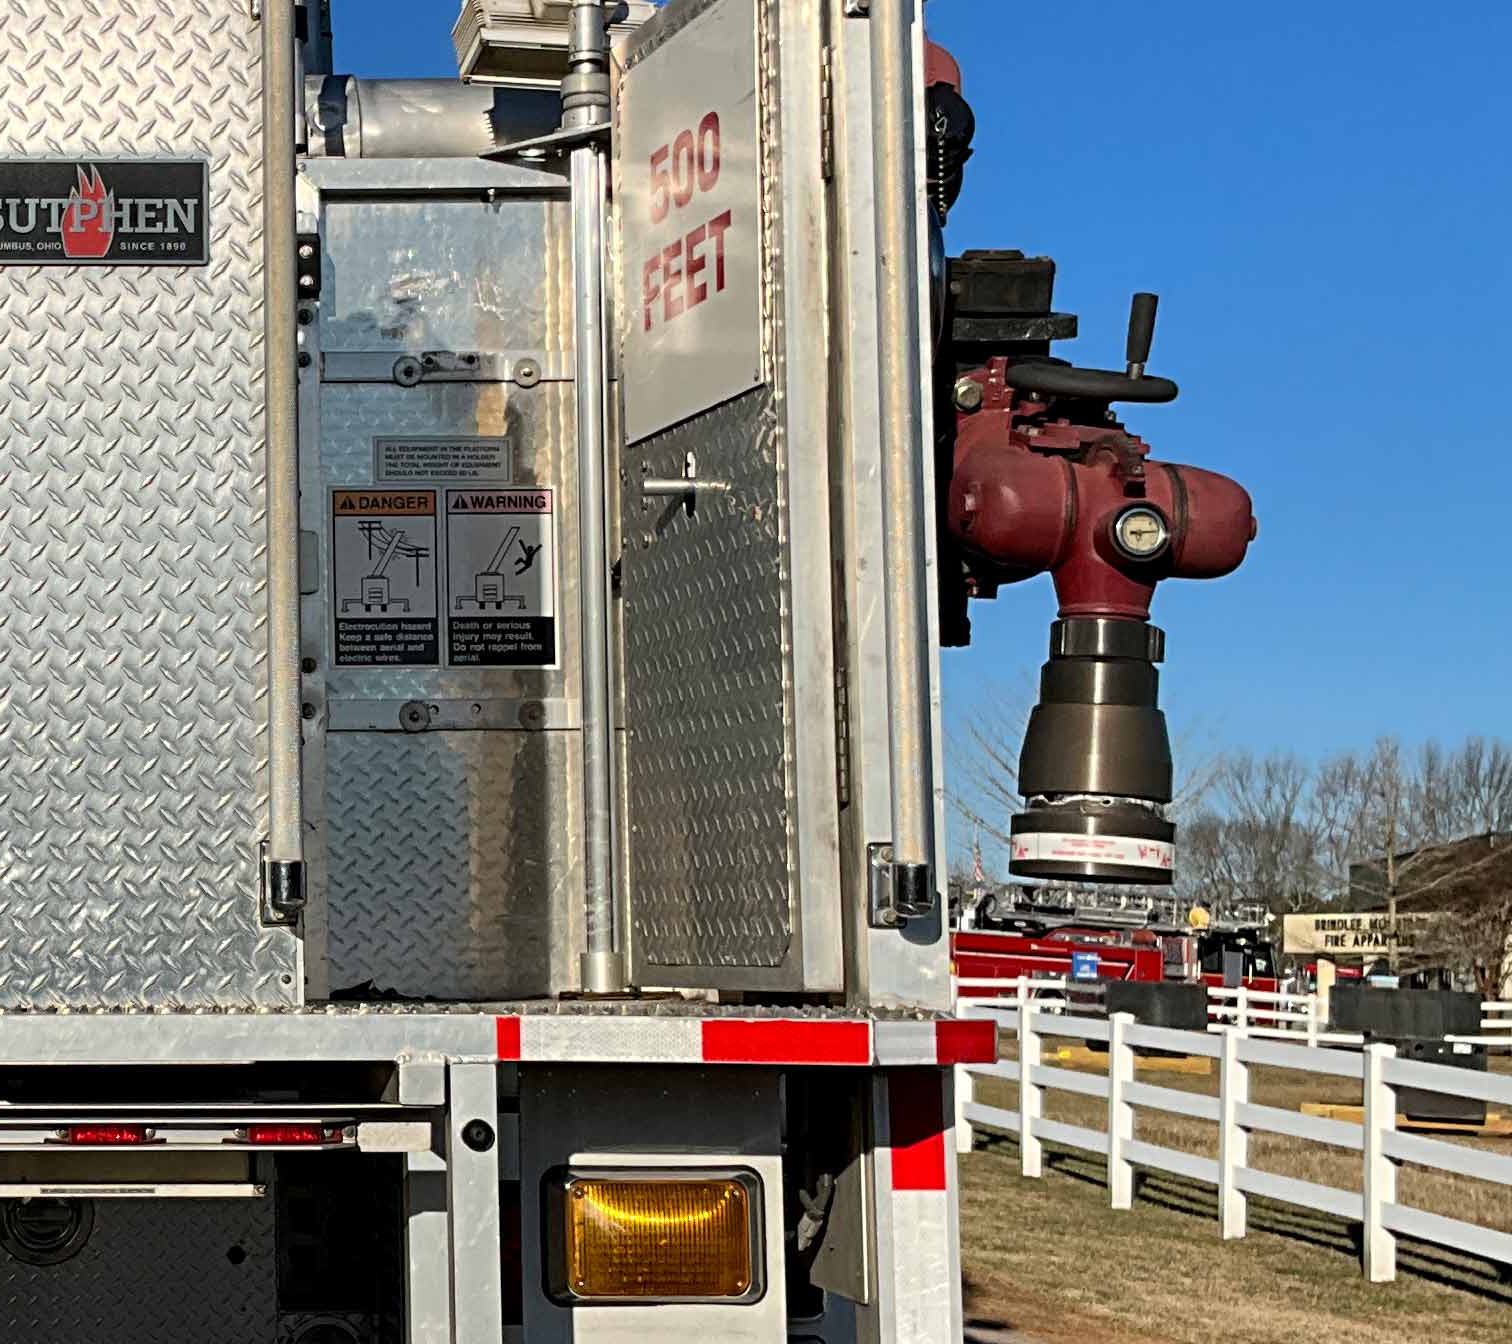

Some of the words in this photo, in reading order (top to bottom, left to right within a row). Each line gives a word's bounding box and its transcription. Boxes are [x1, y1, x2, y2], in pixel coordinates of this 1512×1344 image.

[649, 111, 721, 225] 500
[36, 241, 62, 252] OHIO
[119, 241, 156, 251] SINCE
[642, 208, 732, 333] FEET
[358, 496, 429, 509] DANGER
[470, 495, 547, 509] WARNING
[338, 622, 399, 631] Electrocution
[400, 621, 432, 631] hazard
[452, 621, 480, 630] Death
[482, 622, 492, 630] or
[496, 621, 532, 630] serious
[339, 632, 362, 642] Keep
[374, 632, 393, 641] safe
[395, 632, 434, 642] distance
[482, 633, 502, 643] may
[338, 643, 377, 652] between
[379, 642, 405, 652] aerial
[407, 642, 425, 652] and
[452, 642, 467, 652] Do
[469, 643, 485, 652] not
[488, 642, 518, 654] rappel
[520, 642, 543, 652] from
[1324, 934, 1346, 948] FIRE
